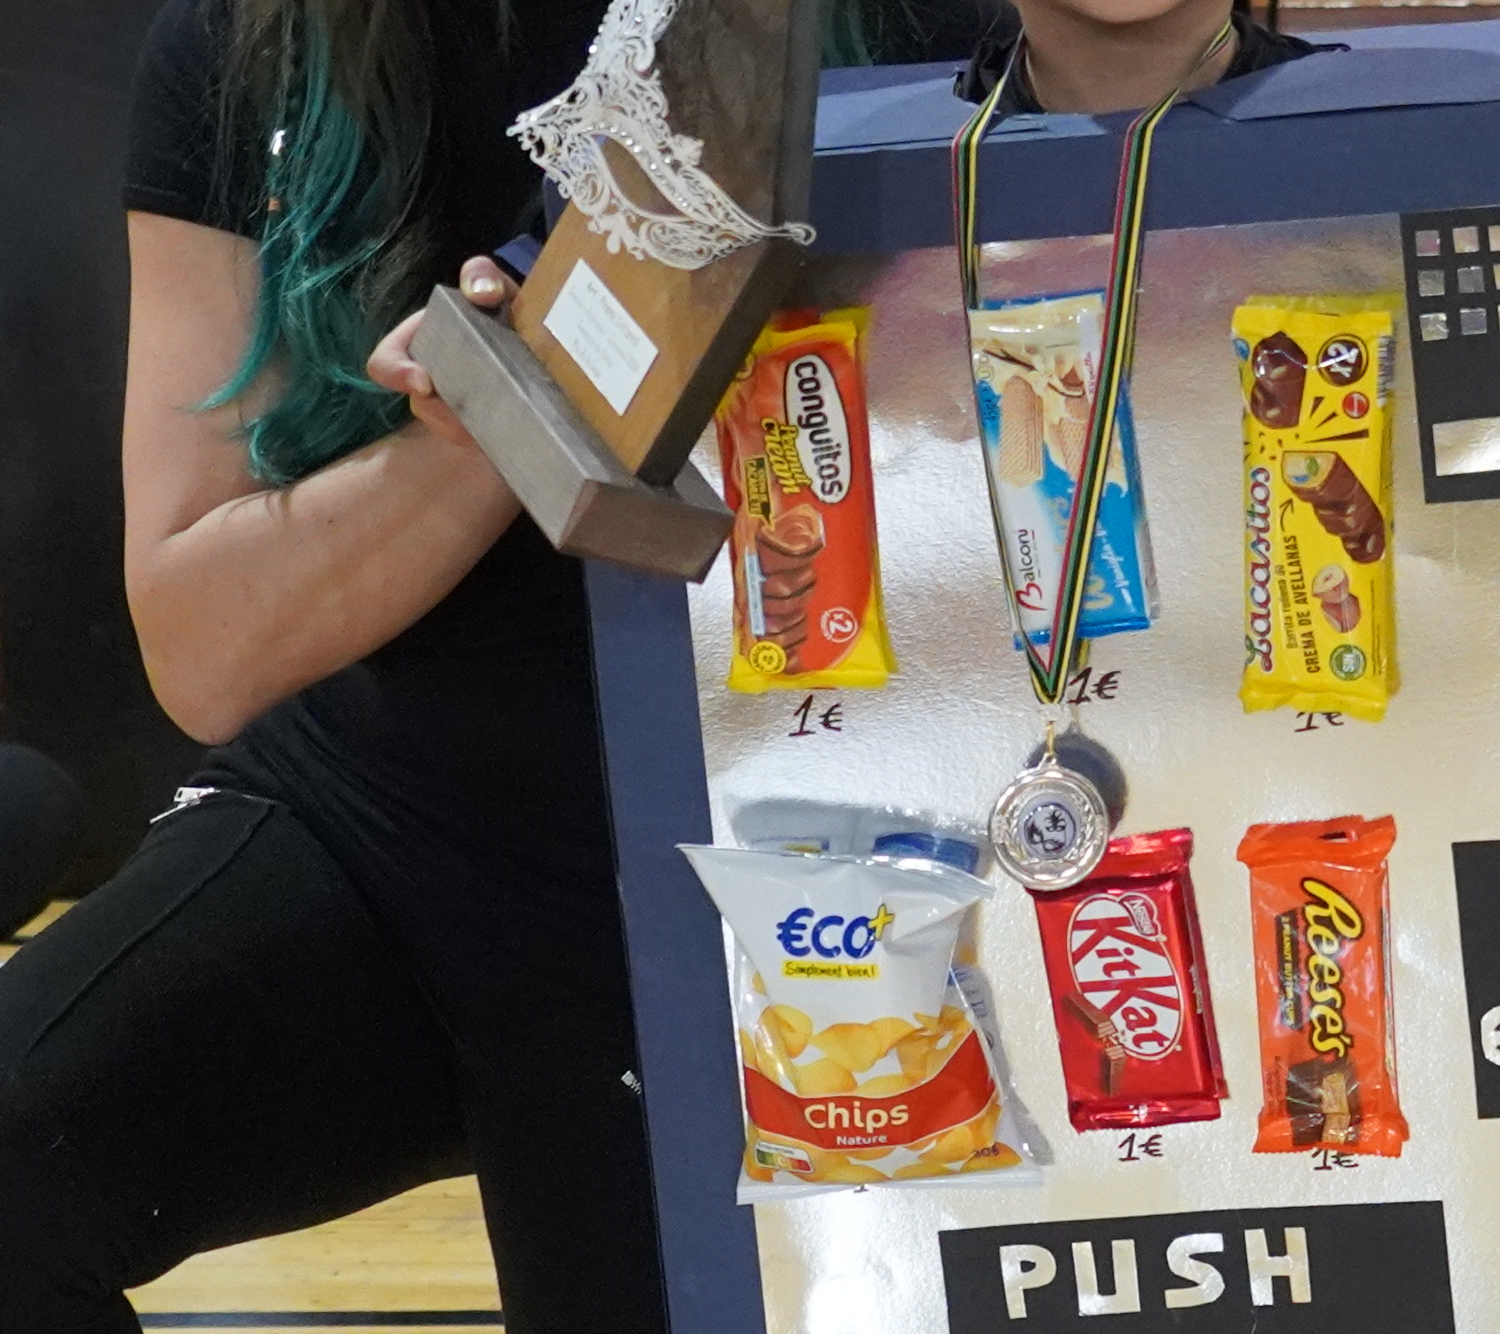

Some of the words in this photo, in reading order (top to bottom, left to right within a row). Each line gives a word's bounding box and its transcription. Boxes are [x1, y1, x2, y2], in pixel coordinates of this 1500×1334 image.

[794, 360, 845, 498] conguitos
[1015, 528, 1048, 611] Balconi
[1244, 467, 1274, 673] Lacasitos
[1284, 534, 1309, 604] AVELLANAS
[1295, 610, 1312, 627] DE
[1300, 630, 1321, 674] CREMA
[1065, 668, 1123, 705] 1€
[788, 693, 845, 737] 1€
[1302, 878, 1363, 1059] Reese's
[804, 1100, 911, 1134] Chips
[836, 1134, 889, 1147] Nature
[1118, 1132, 1166, 1163] 1€
[999, 1226, 1312, 1320] PUSH
